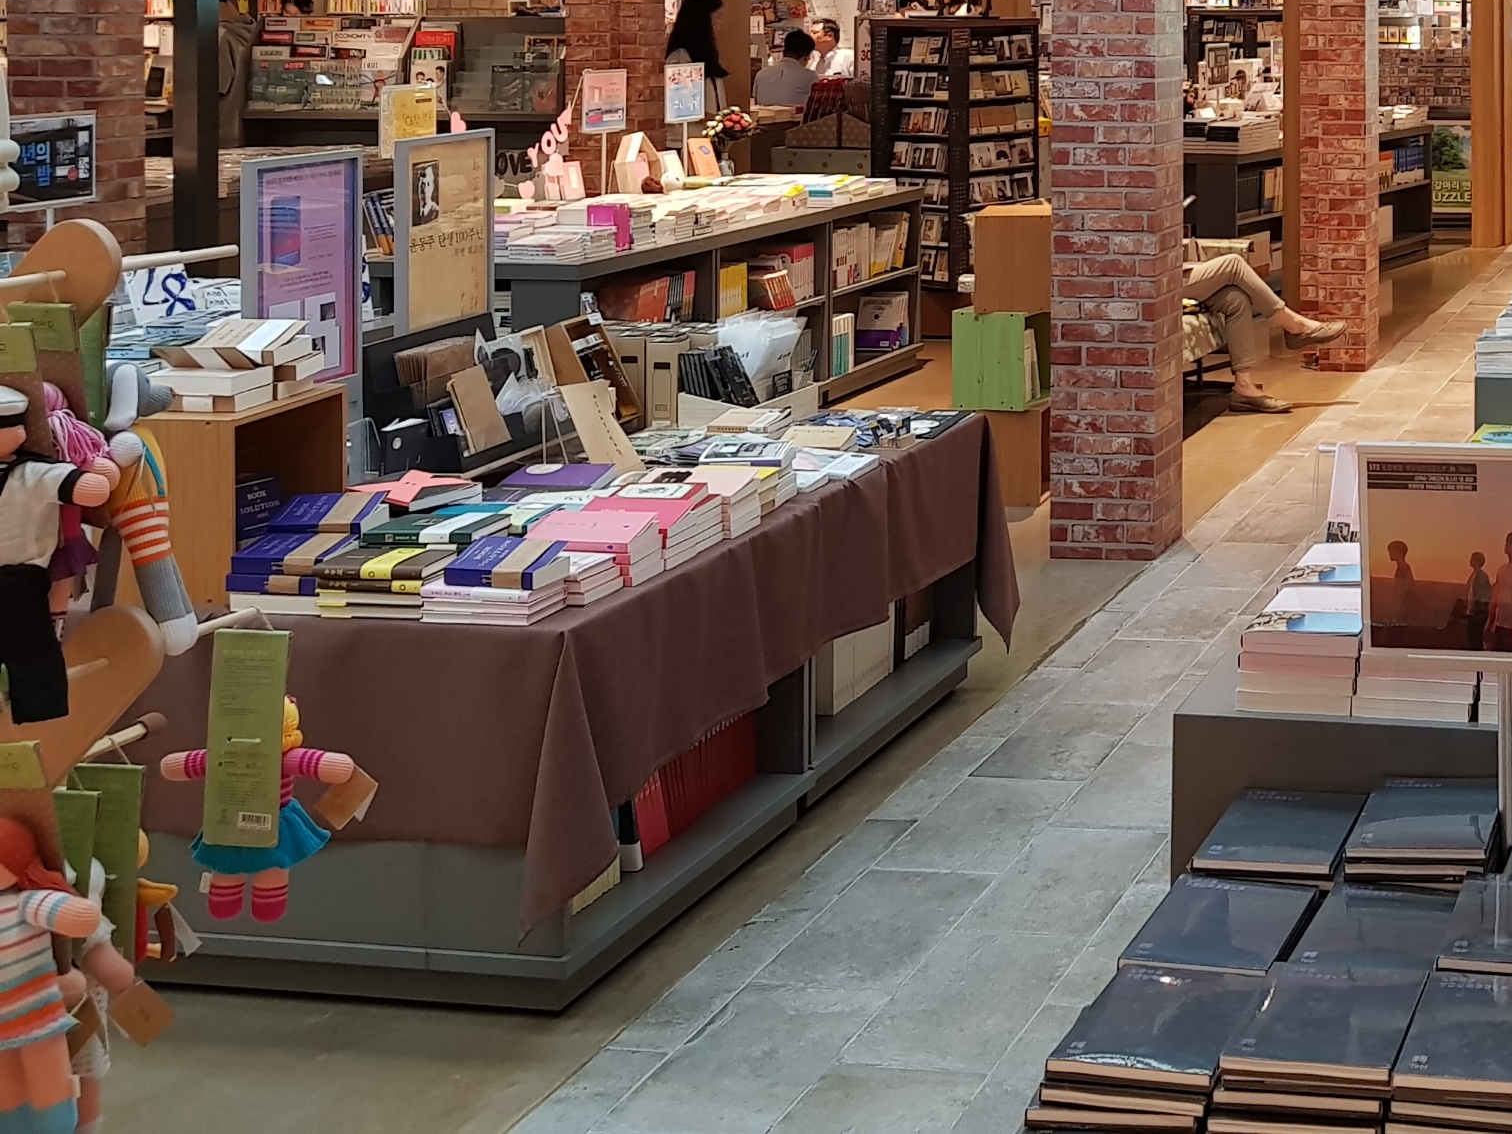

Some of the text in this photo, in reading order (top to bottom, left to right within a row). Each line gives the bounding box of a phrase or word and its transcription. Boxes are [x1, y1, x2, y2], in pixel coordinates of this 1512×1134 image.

[21, 141, 51, 165] 년의
[495, 150, 532, 176] OVE
[1433, 180, 1459, 191] 강머리
[1433, 191, 1471, 202] UZZLE
[409, 227, 484, 253] 윤동주 탄생 100주년
[247, 490, 267, 501] BOOK
[240, 499, 280, 515] SOLUTION
